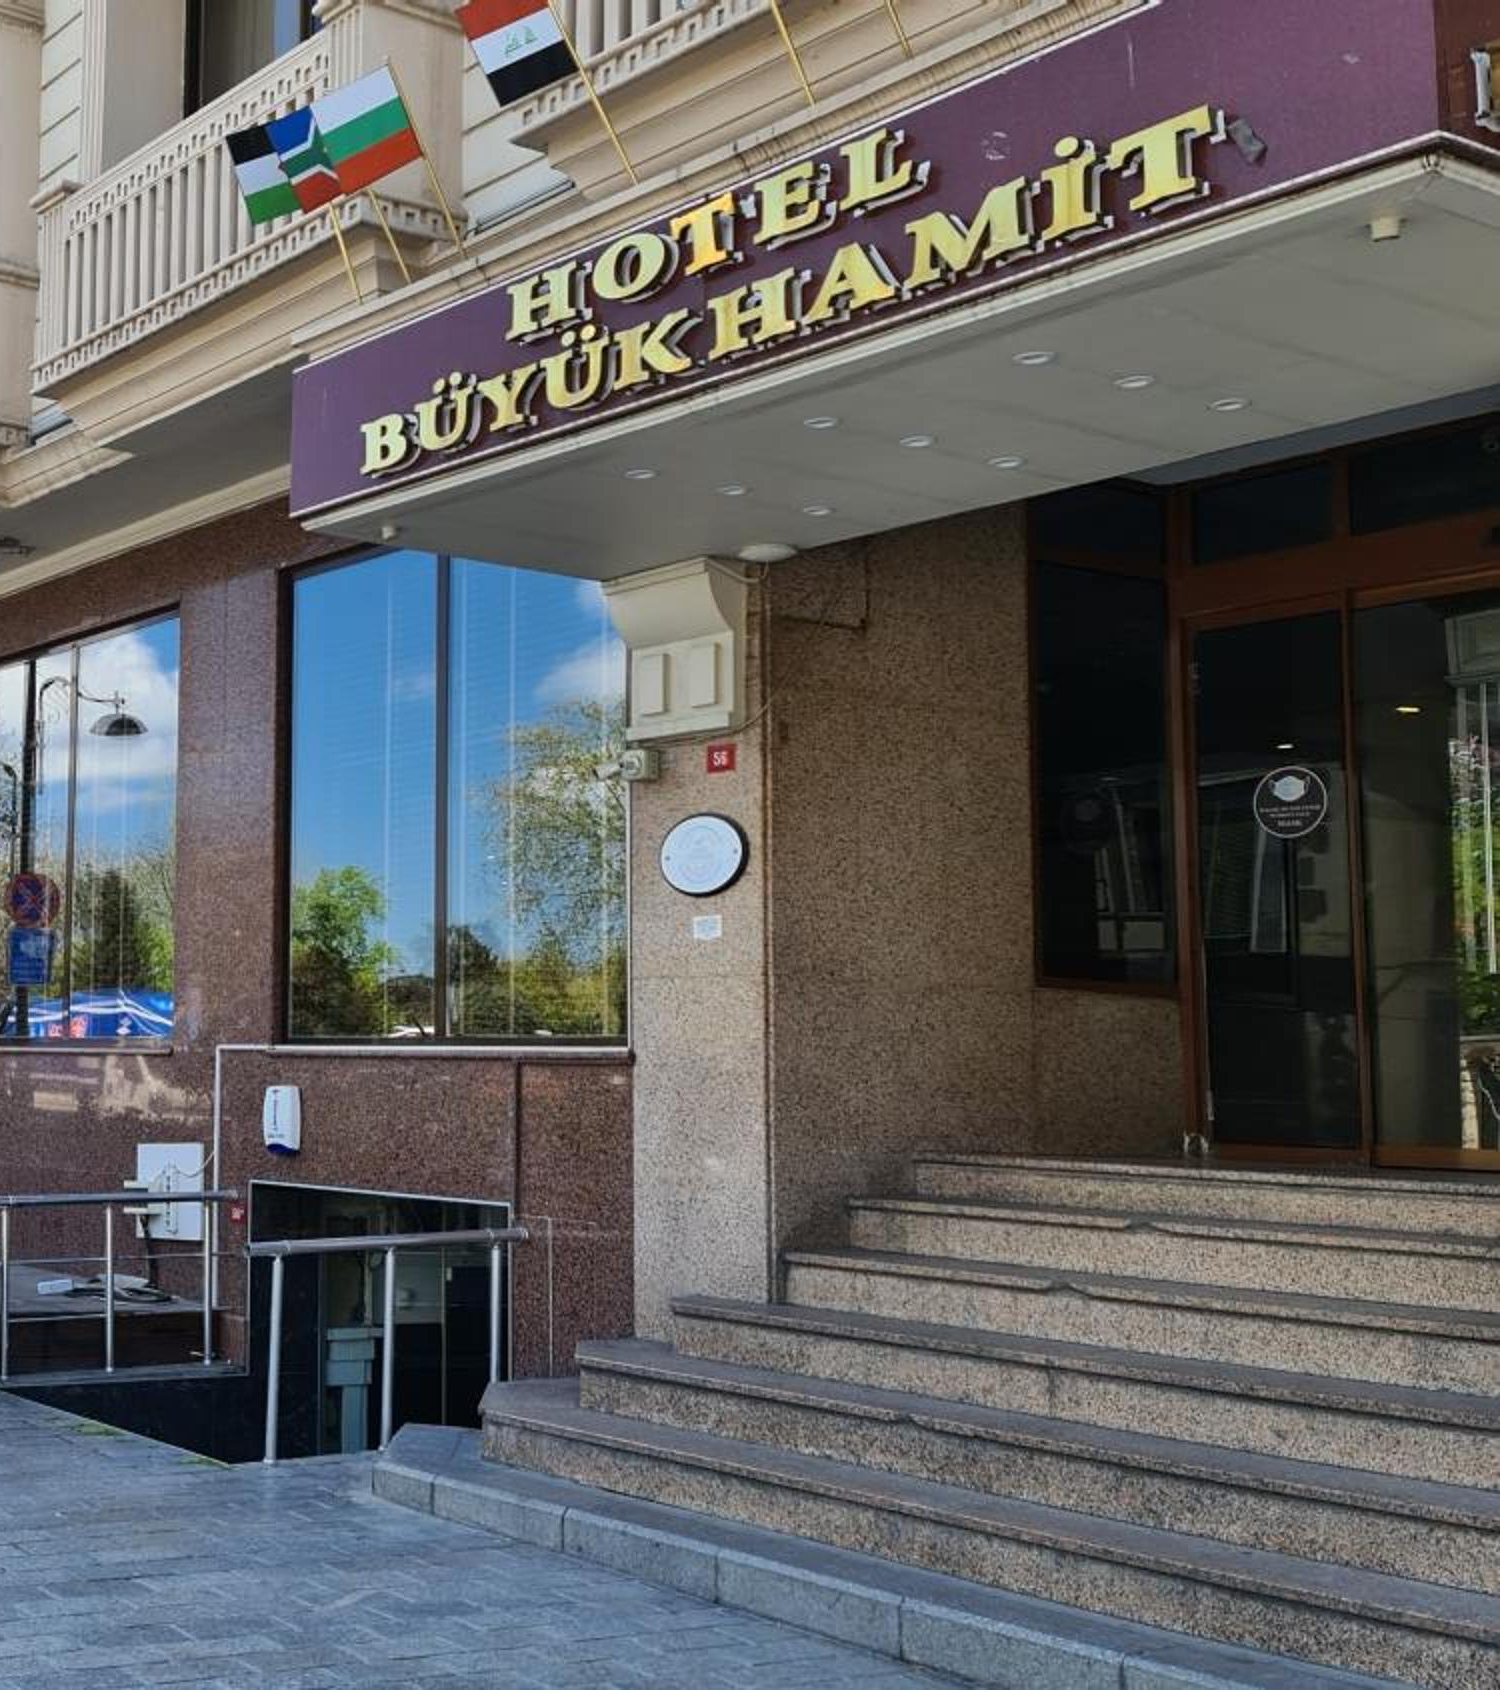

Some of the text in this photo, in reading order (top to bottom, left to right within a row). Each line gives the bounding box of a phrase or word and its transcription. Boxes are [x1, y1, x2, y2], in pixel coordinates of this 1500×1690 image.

[359, 103, 1222, 478] BÜYÜKHAMİT
[505, 128, 926, 344] HOTEL
[713, 751, 728, 767] 56
